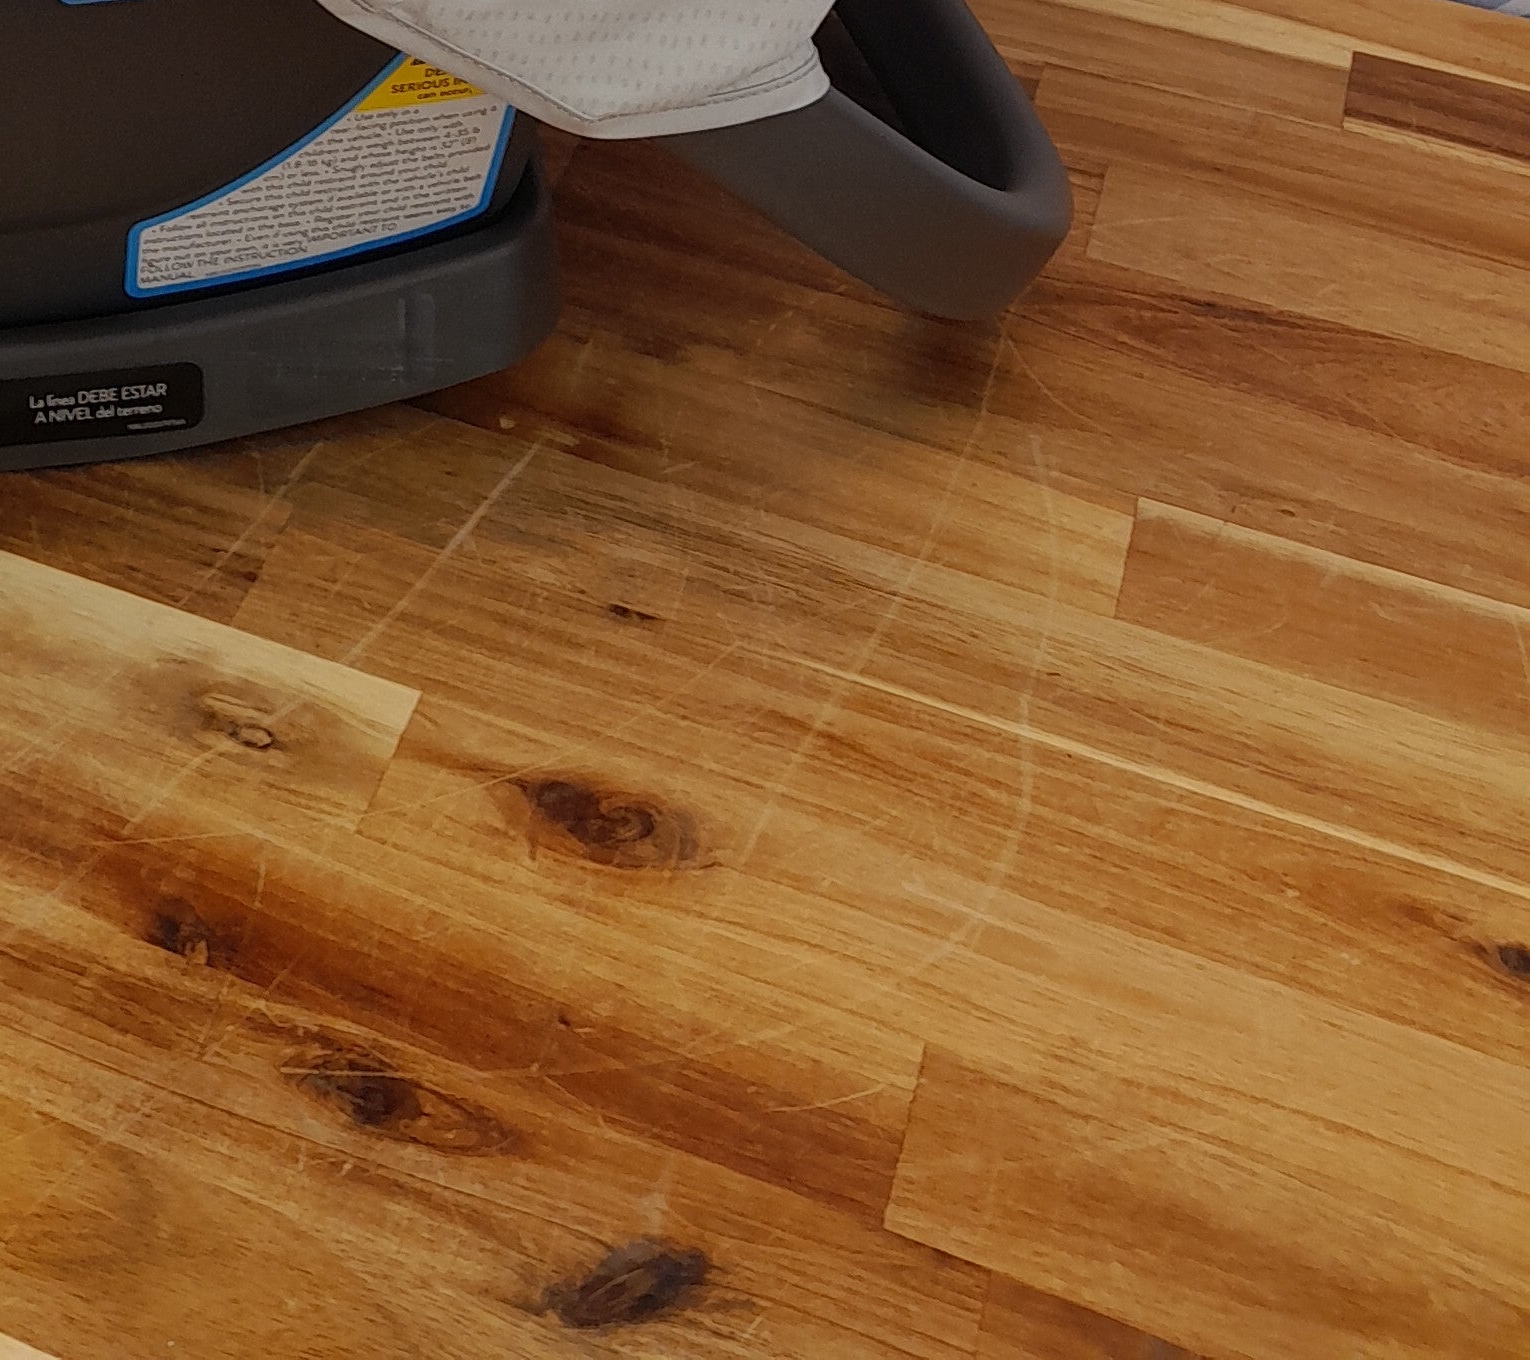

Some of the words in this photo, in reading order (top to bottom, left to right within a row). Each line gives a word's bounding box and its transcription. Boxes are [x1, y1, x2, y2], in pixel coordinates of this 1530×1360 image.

[390, 77, 449, 94] SERIOUS
[28, 395, 45, 409] La
[77, 387, 118, 404] DEBE
[120, 382, 167, 400] ESTAR
[33, 410, 47, 424] A
[48, 406, 93, 422] NIVEL
[94, 404, 115, 418] del
